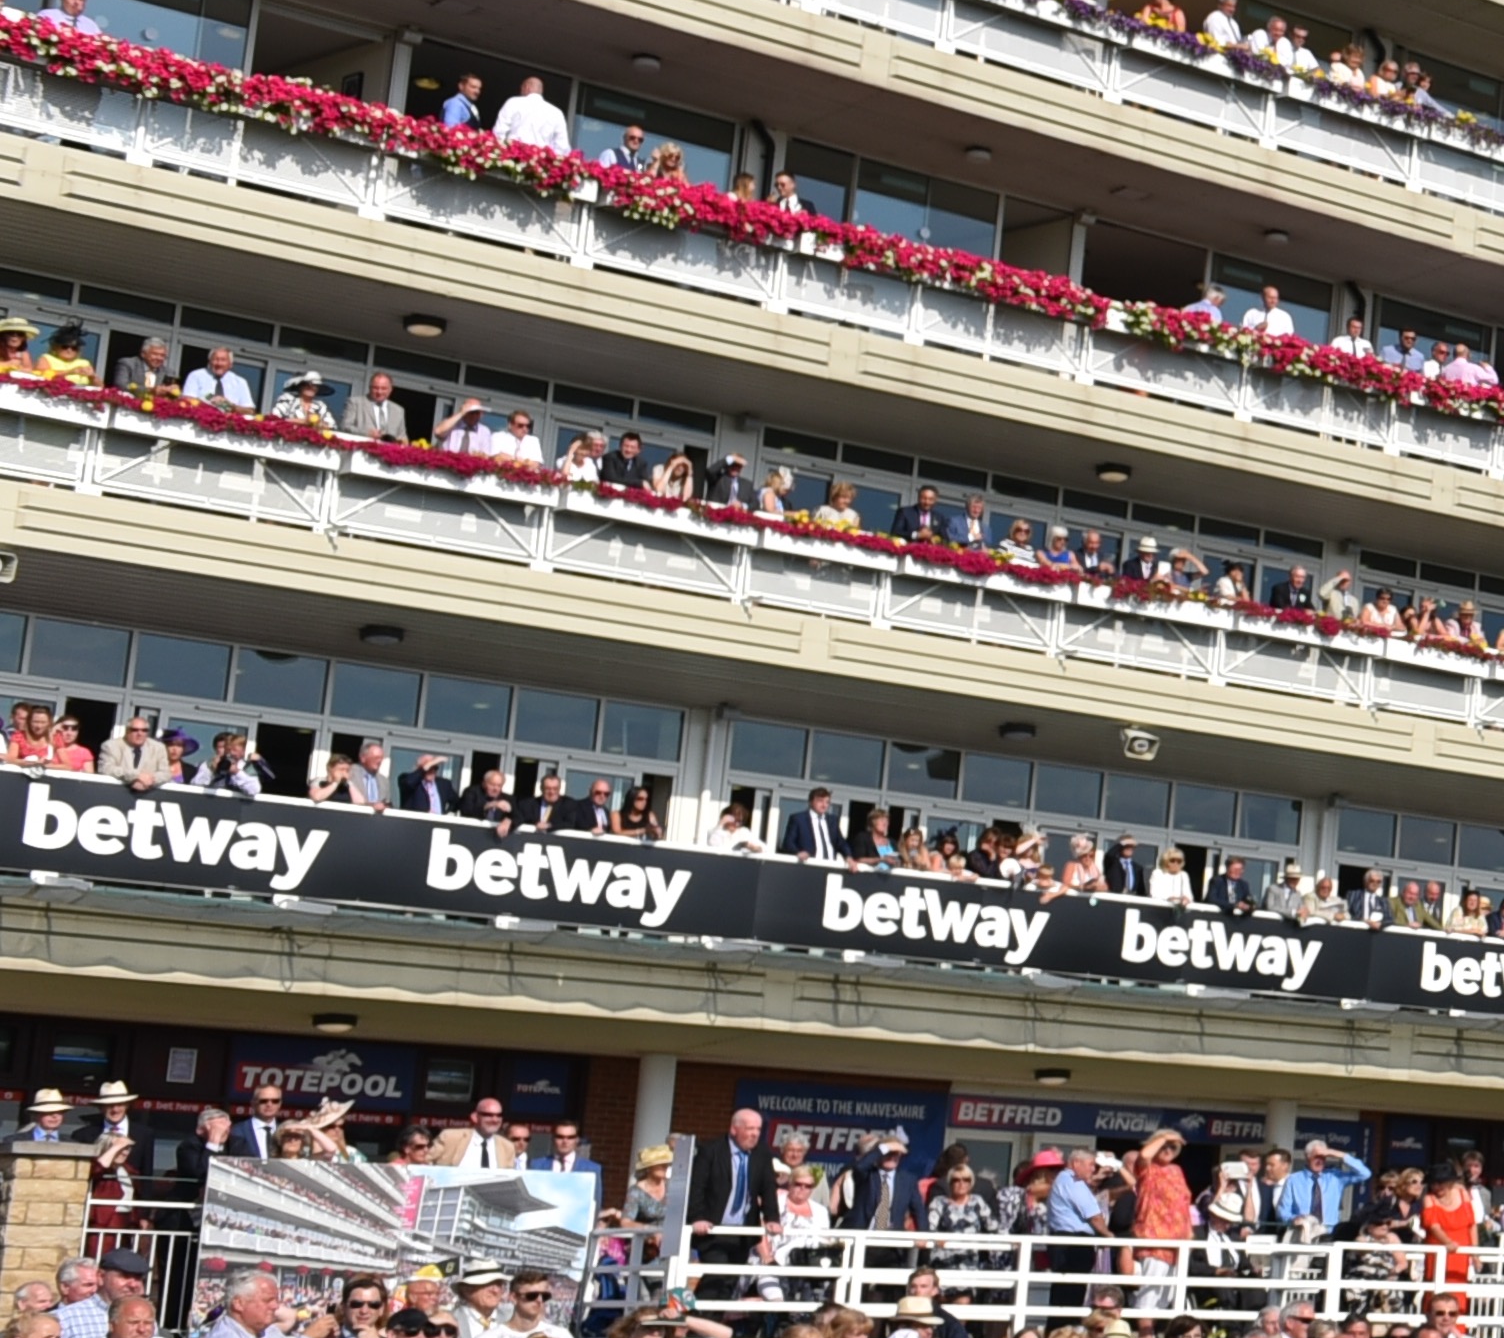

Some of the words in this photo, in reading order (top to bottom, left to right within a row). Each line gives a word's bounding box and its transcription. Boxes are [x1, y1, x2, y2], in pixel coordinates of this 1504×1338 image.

[22, 782, 329, 891] betway
[427, 828, 691, 928] betway
[823, 872, 1050, 965] betway
[1121, 908, 1323, 991] betway
[242, 1065, 402, 1099] TOTEPOOL
[758, 1094, 814, 1114] WELCOME
[816, 1098, 830, 1114] TO
[832, 1099, 853, 1115] THE
[855, 1100, 926, 1120] KNAVESMIRE
[957, 1101, 1063, 1127] BETFRED
